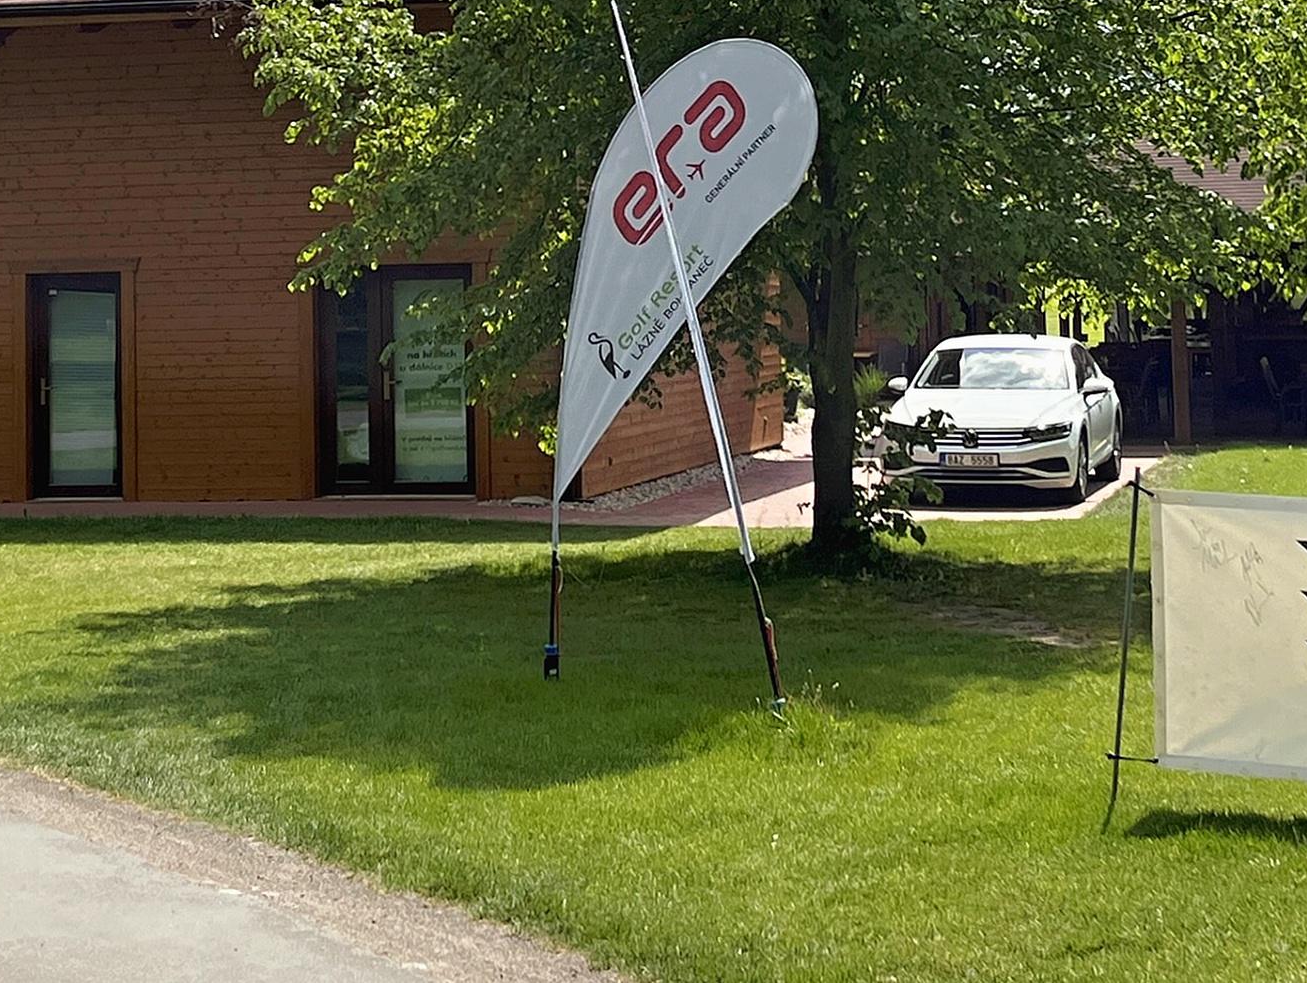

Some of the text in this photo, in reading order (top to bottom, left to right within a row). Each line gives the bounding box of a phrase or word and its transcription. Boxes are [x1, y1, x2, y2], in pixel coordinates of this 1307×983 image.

[705, 124, 776, 204] GENERÁLNÍ PARTNER
[617, 304, 653, 351] Golf
[630, 316, 666, 361] LÁZNĚ
